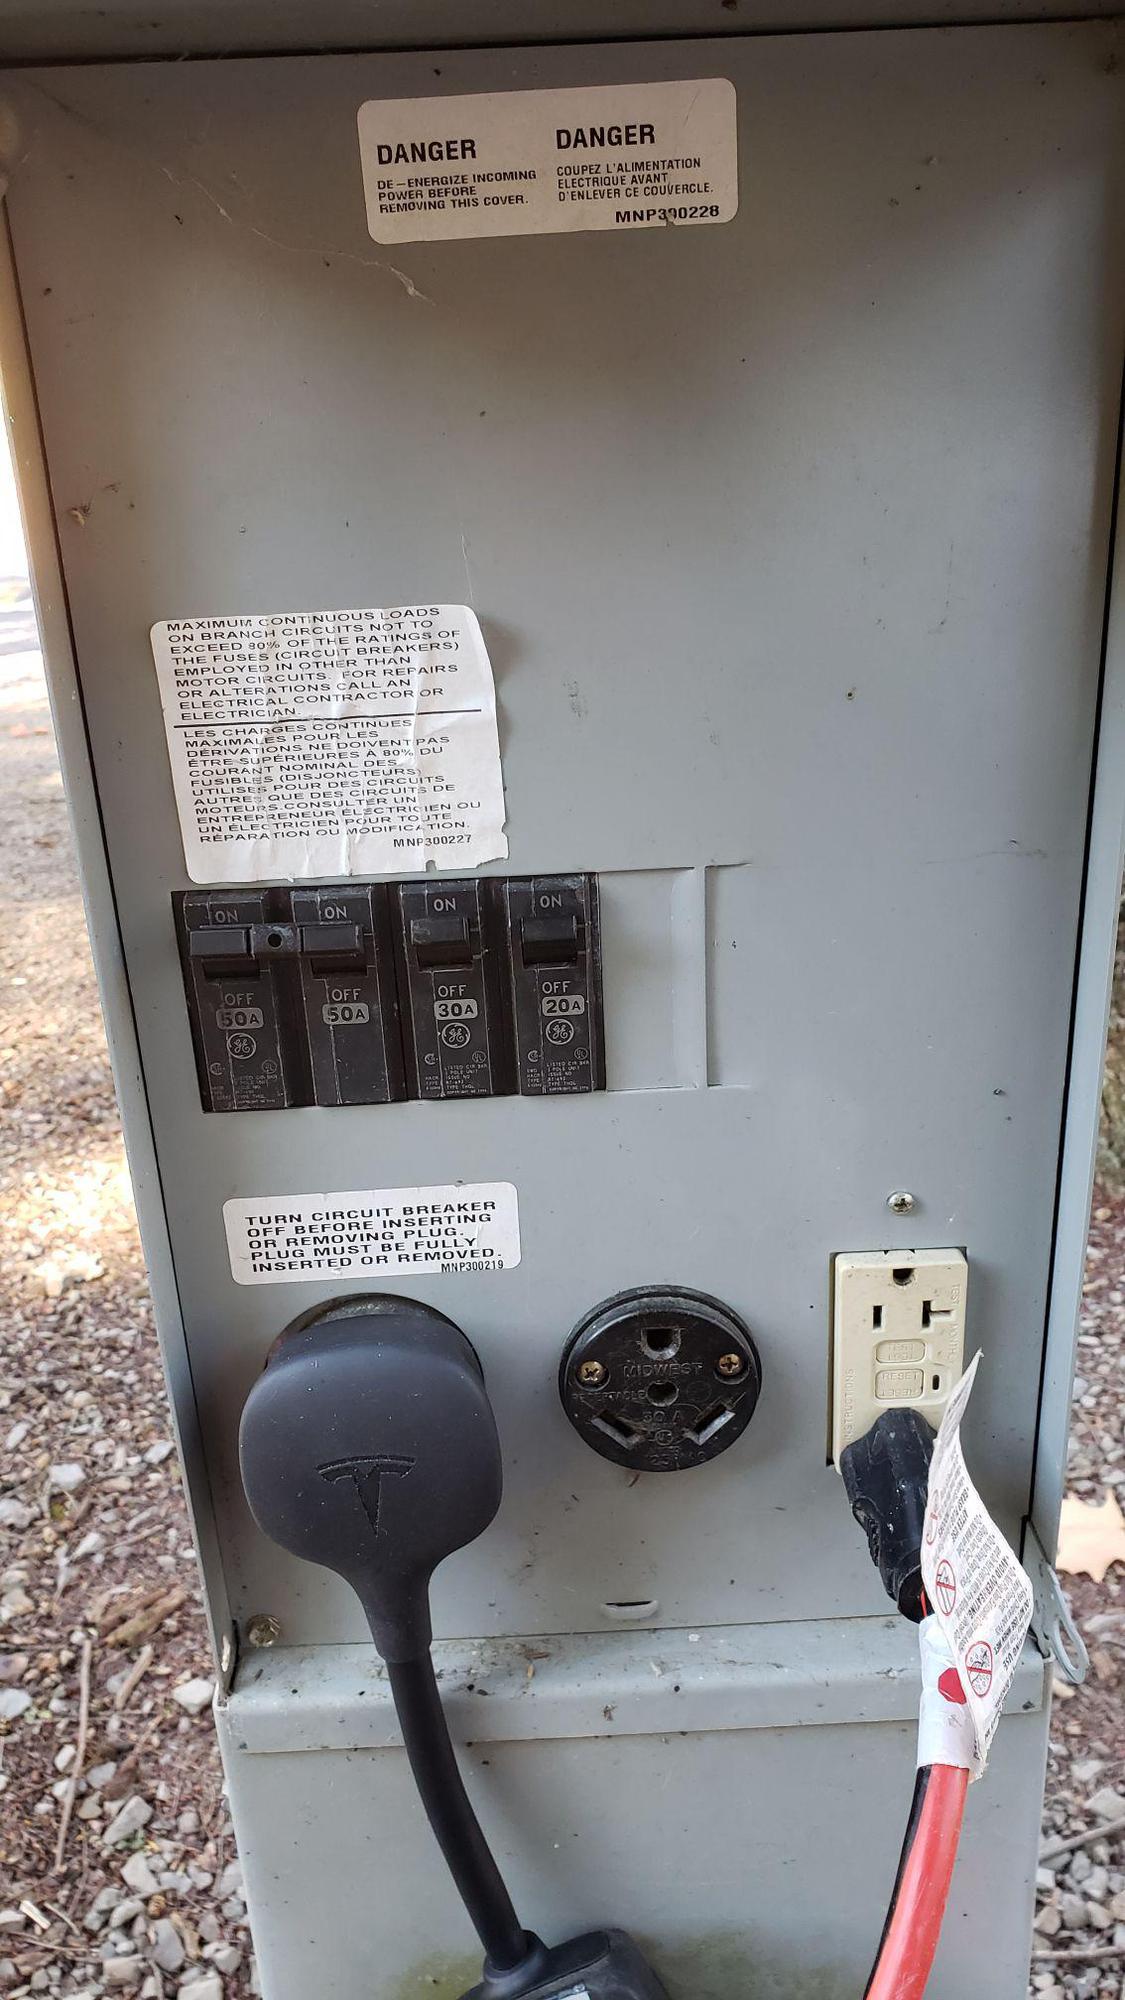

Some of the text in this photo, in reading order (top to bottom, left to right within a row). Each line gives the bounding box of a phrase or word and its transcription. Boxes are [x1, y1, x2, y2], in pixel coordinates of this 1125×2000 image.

[556, 124, 656, 150] DANGER
[377, 139, 477, 165] DANGER
[556, 157, 701, 177] COUPEZ L'ALIMENTATION
[472, 169, 537, 184] INCOMING
[557, 172, 668, 190] ELECTRIQUE AVANT
[378, 185, 477, 202] POWER BEFORE
[558, 182, 714, 202] D'ENLEVER CE COUVERCLE.
[379, 194, 529, 214] REMOVING THIS COVER.
[167, 607, 440, 632] MAXIMUM CONTINUOUS LOADS
[168, 620, 433, 643] ON BRANCH CIRCUITS NOT TO
[170, 630, 461, 654] EXCEED 80% OF THE RATINGS OF
[172, 641, 459, 665] THE FUSES (CIRCUIT BREAKERS)
[174, 656, 411, 677] EMPLOYED IN OTHER THAN
[176, 677, 240, 687] MOTOR
[245, 672, 332, 684] CIRCUITS.
[342, 669, 377, 679] FOR
[177, 679, 411, 698] OR ALTERATIONS CALL AN
[179, 688, 444, 710] ELECTRICAL CONTRACTOR OR
[181, 708, 301, 721] ELECTRICIAN.
[183, 719, 412, 738] LES CHARGES CONTINUES
[185, 731, 379, 748] MAXIMALES POUR LES
[309, 742, 334, 750] NE
[337, 739, 411, 750] DOIVENT
[416, 736, 450, 746] PAS
[239, 751, 360, 765] SUPÉRIEURES
[383, 749, 414, 757] 80%
[420, 747, 443, 756] DU
[189, 759, 397, 777] COURANT NOMINAL DES
[191, 769, 422, 787] FUSIBLES (DISJONCTEURS)
[273, 782, 321, 791] POUR
[328, 780, 361, 789] DES
[367, 775, 445, 787] CIRCUITS
[268, 793, 304, 801] QUE
[310, 791, 344, 799] DES
[349, 786, 427, 797] CIRCUITS
[433, 784, 456, 792] DE
[394, 796, 416, 804] UN
[197, 810, 335, 824] ENTREPRENEUR
[457, 801, 481, 809] OU
[199, 826, 222, 834] UN
[345, 816, 392, 825] POUR
[200, 830, 310, 843] RÉPARATION
[316, 829, 340, 837] OU
[394, 835, 472, 847] MNP300227
[434, 898, 457, 912] ON
[540, 894, 562, 908] ON
[216, 910, 239, 924] ON
[325, 906, 347, 919] ON
[332, 988, 361, 1001] OFF
[438, 984, 467, 998] OFF
[542, 981, 571, 995] OFF
[225, 993, 254, 1006] OFF
[546, 998, 581, 1013] 20A
[221, 1010, 259, 1027] 50A
[327, 1006, 365, 1022] 50A
[438, 1002, 474, 1017] 30A
[245, 1201, 497, 1226] TURN CIRCUIT BREAKER
[247, 1213, 491, 1238] OFF BEFORE INSERTING
[249, 1227, 464, 1250] OR REMOVING PLUG.
[251, 1237, 477, 1261] PLUG MUST BE FULLY
[252, 1247, 502, 1273] INSERTED OR REMOVED.
[441, 1260, 504, 1273] MNP300219
[623, 1362, 704, 1378] MIDWEST
